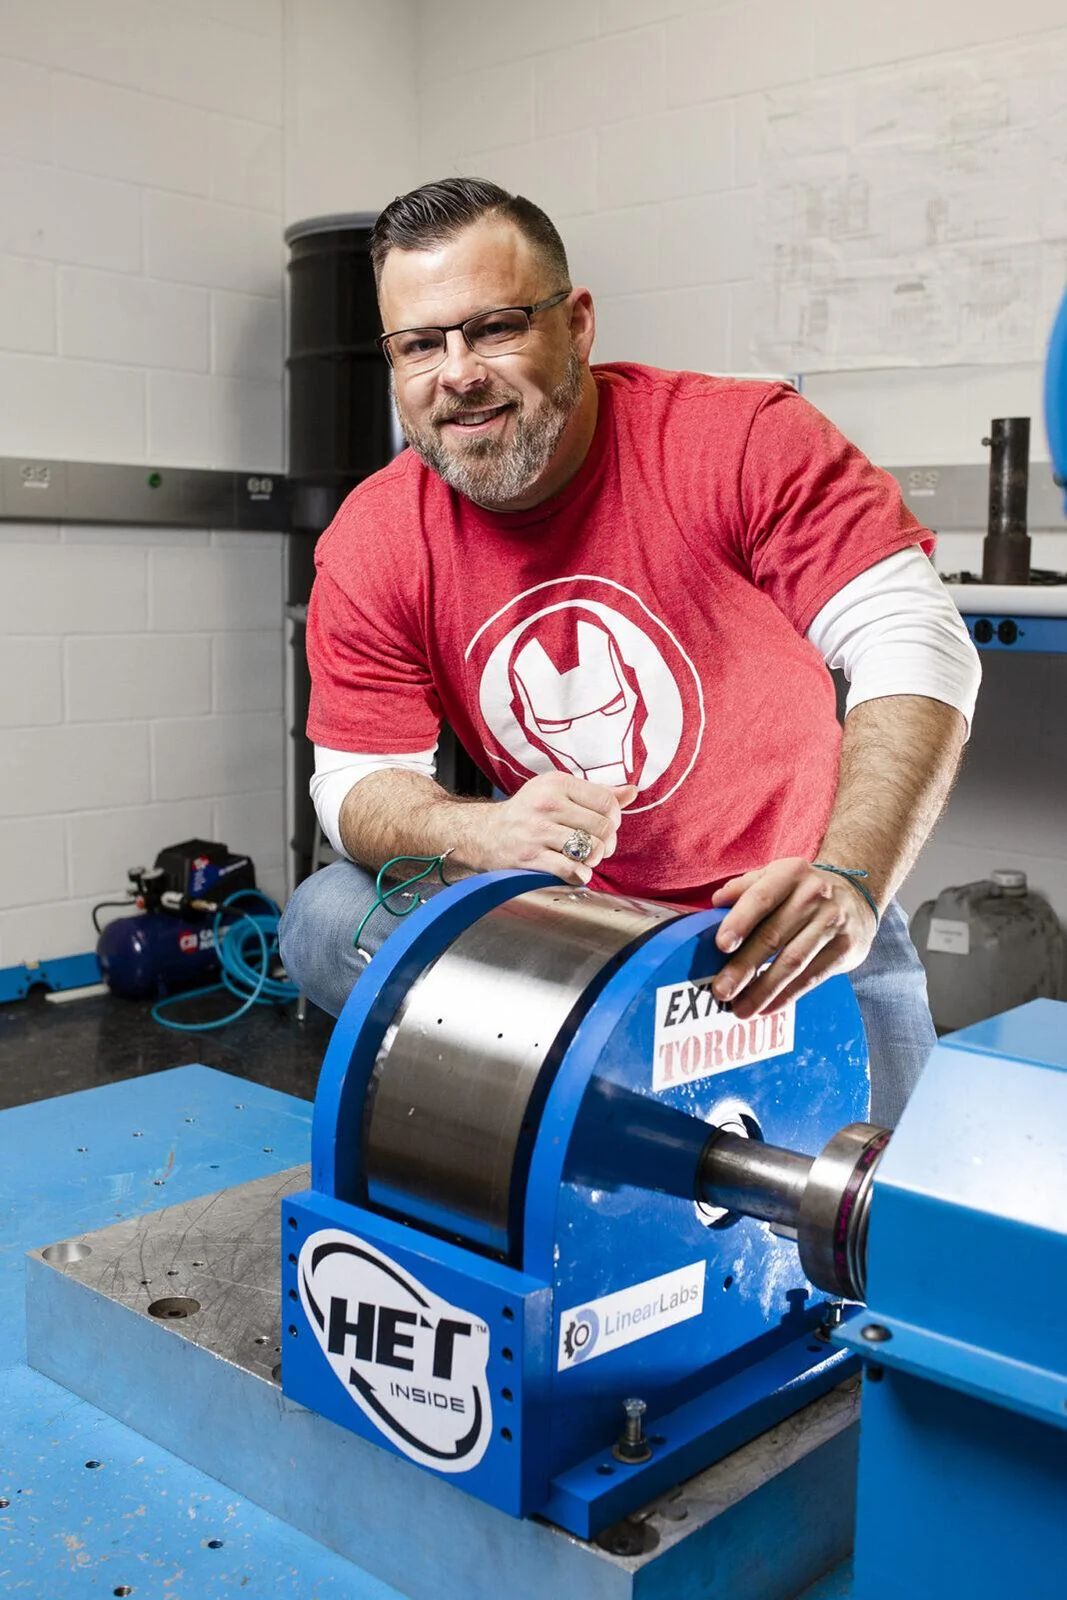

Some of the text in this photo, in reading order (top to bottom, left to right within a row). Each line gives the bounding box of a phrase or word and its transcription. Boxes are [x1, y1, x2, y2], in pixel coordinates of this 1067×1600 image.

[659, 1011, 787, 1081] TORQUE
[328, 1296, 472, 1380] HET
[604, 1284, 699, 1336] LinearLabs
[390, 1382, 465, 1414] INSIDE
